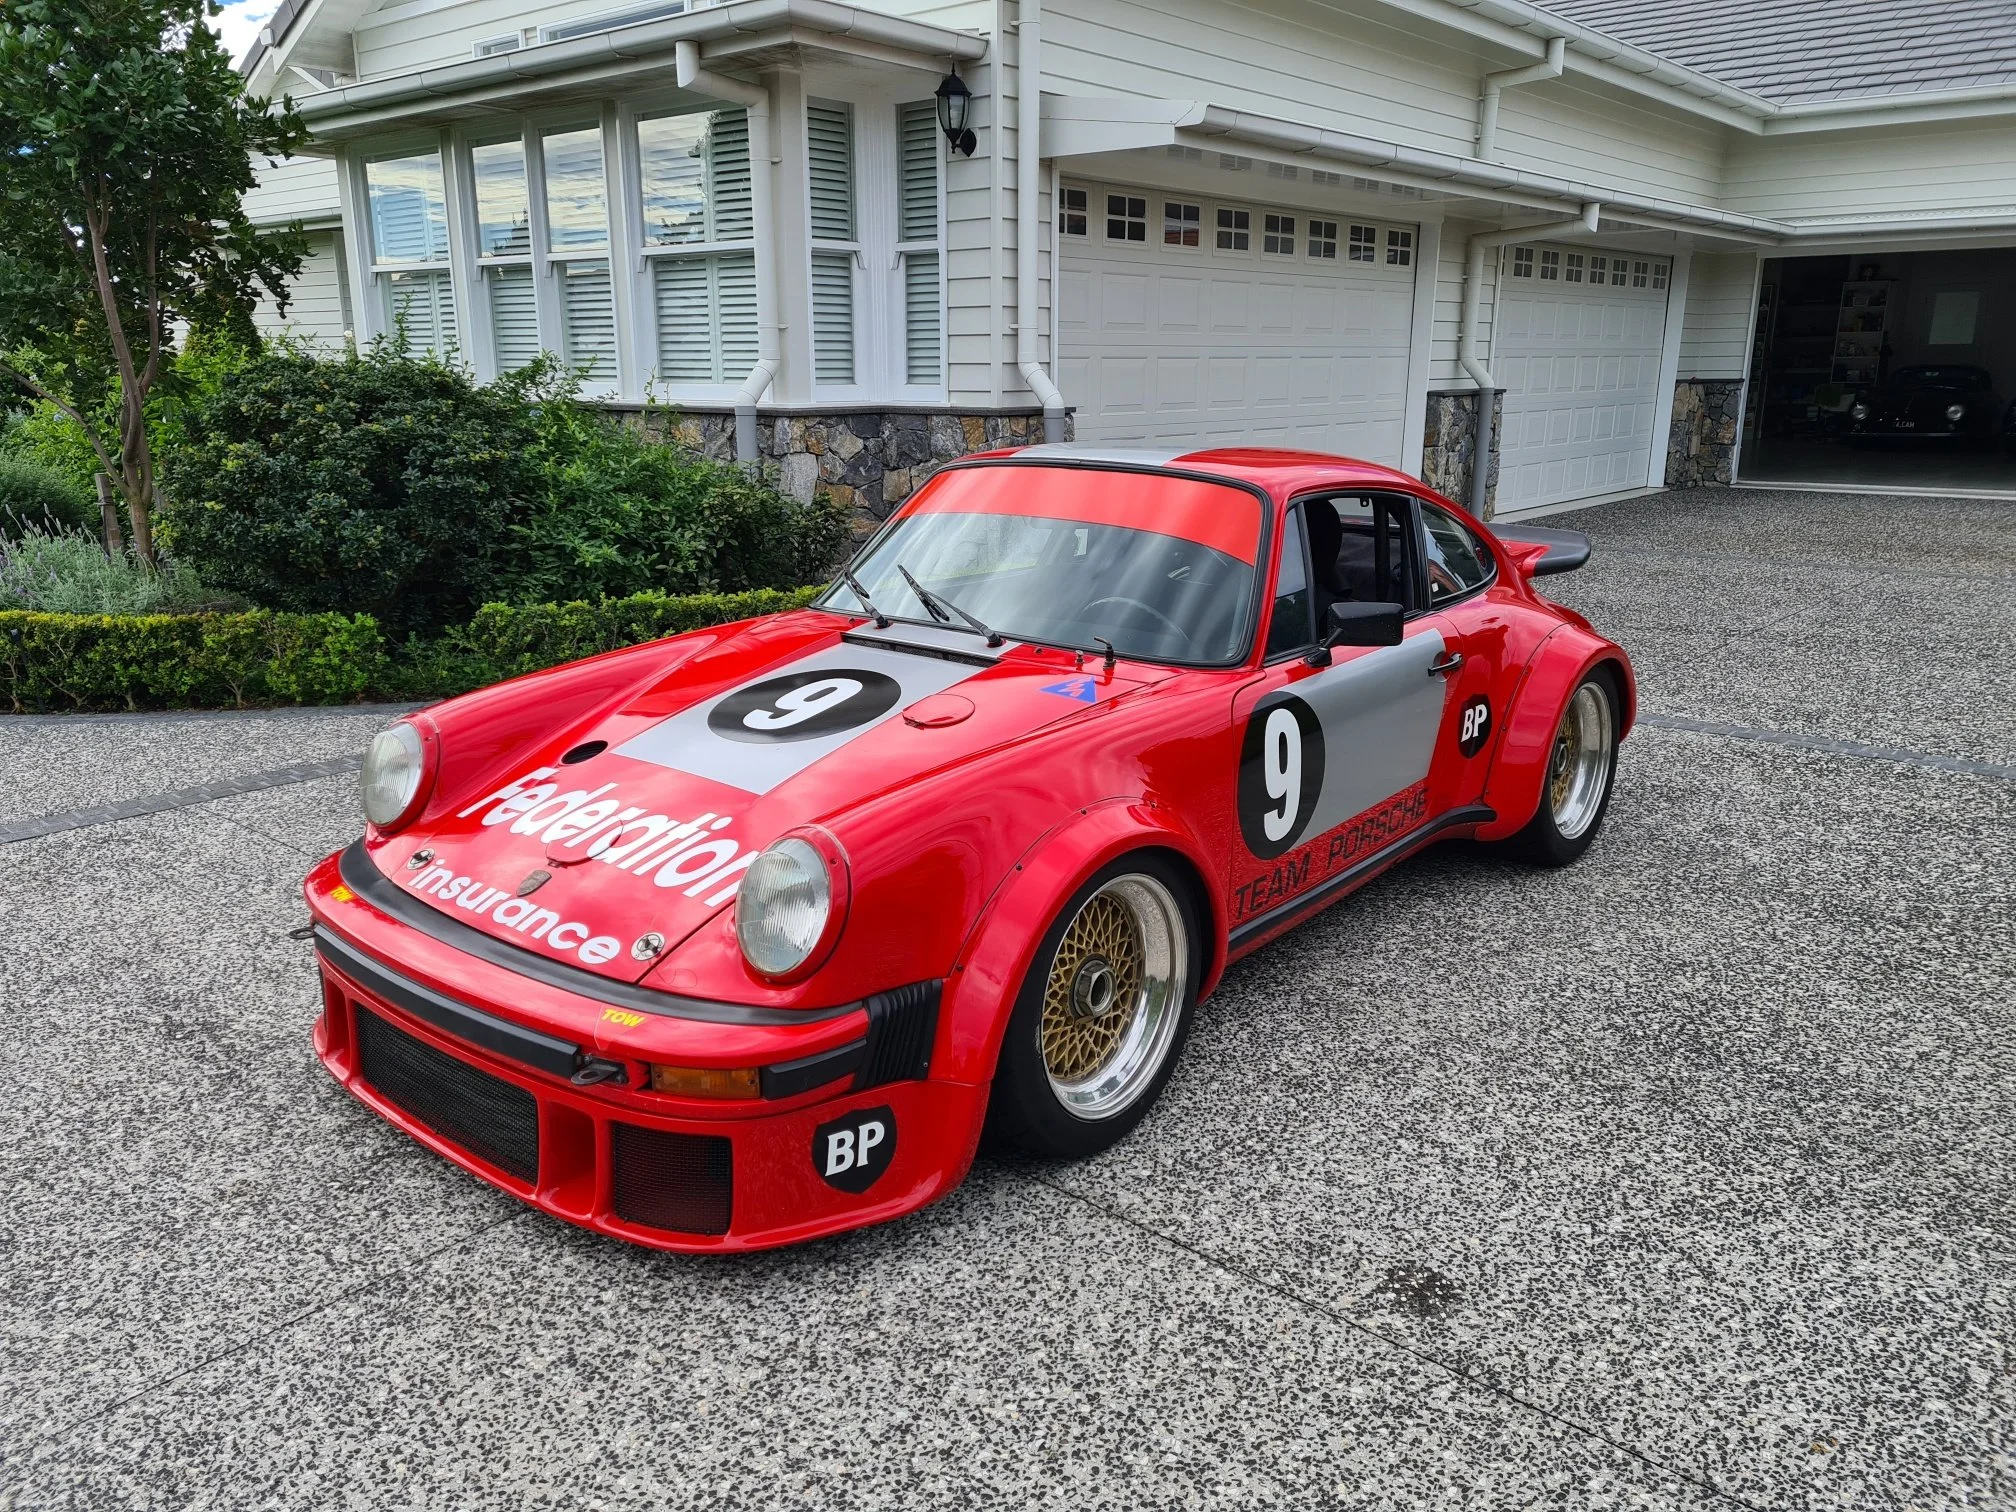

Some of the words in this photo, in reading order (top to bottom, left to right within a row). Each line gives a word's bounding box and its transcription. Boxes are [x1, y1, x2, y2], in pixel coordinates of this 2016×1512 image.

[742, 678, 863, 730] 9
[1461, 704, 1488, 742] BP
[1263, 708, 1302, 842] 9
[456, 766, 760, 908] Federation
[1235, 851, 1312, 920] TEAM
[1327, 787, 1428, 870] PORSCHE
[407, 858, 621, 964] insurance
[601, 1008, 646, 1027] TOW
[824, 1121, 886, 1177] BP
